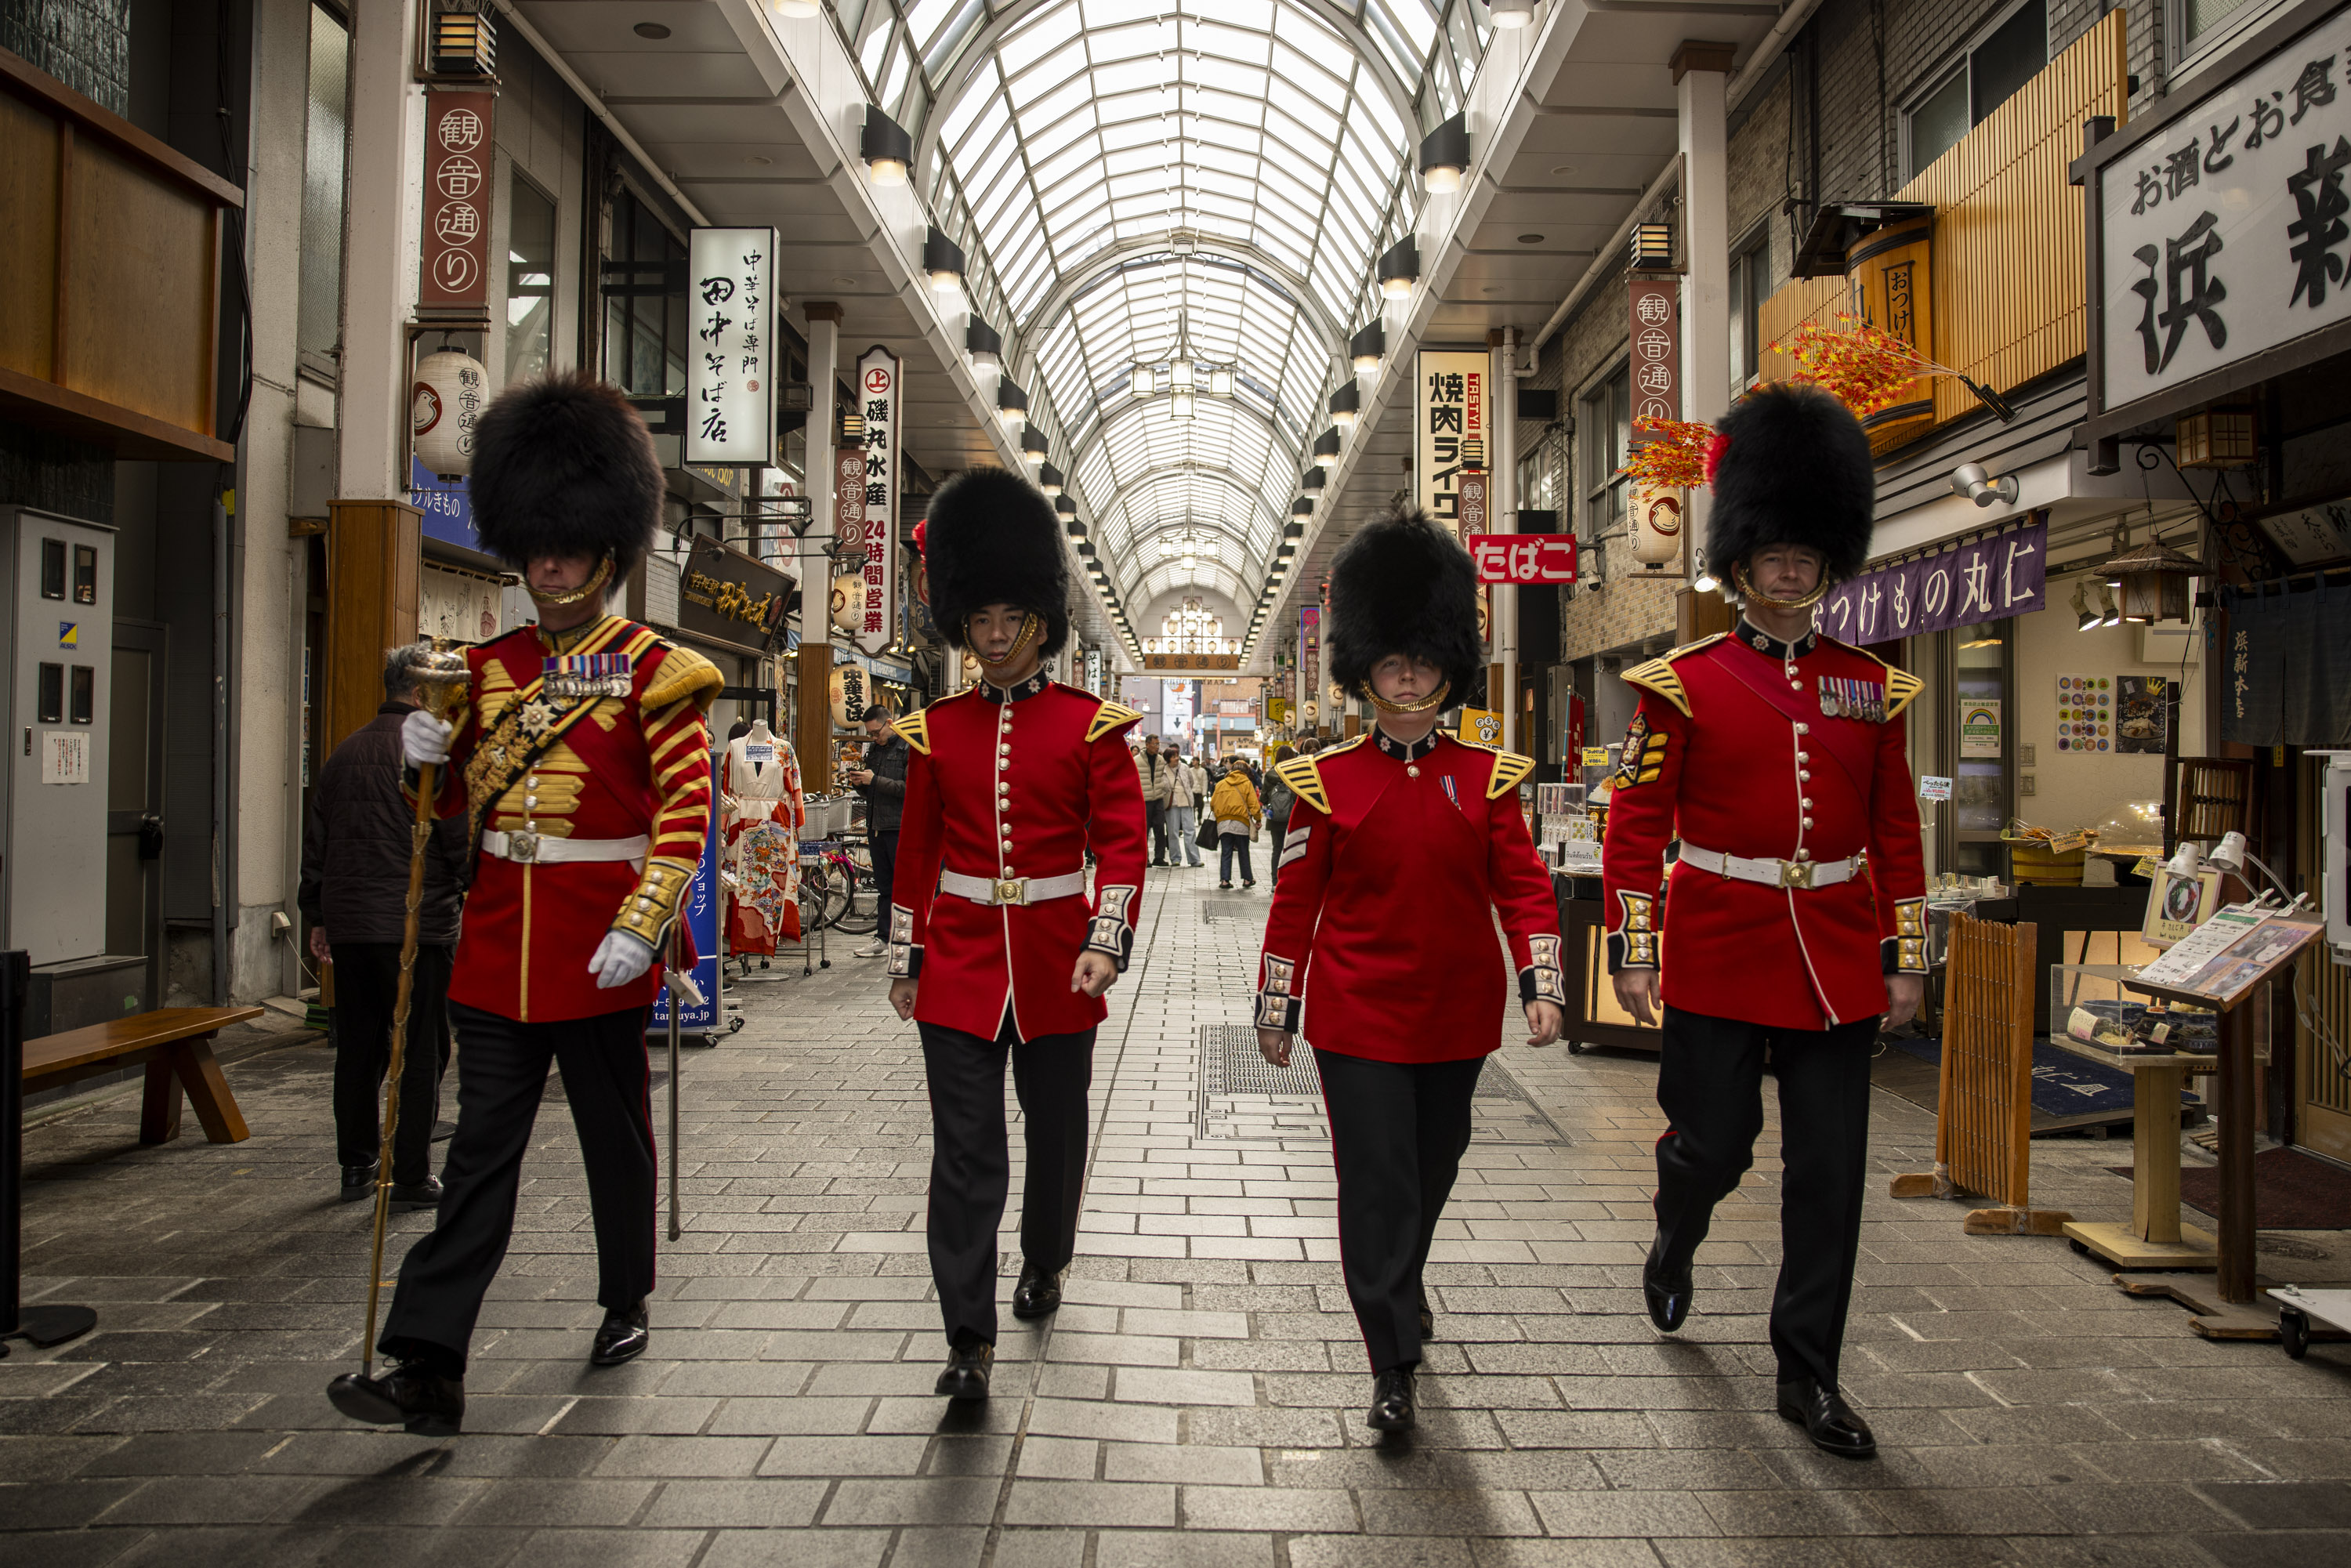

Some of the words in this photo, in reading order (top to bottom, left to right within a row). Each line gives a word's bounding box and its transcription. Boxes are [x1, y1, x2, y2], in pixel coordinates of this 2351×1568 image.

[435, 110, 482, 291] 観音通り
[699, 277, 735, 443] 田中そば店
[743, 249, 762, 375] 中華そば専門
[1638, 294, 1671, 429] 観音通り
[865, 399, 889, 506] 磯丸水産
[1429, 372, 1464, 519] 焼肉ライク
[1469, 376, 1480, 426] TASTY!
[841, 458, 863, 545] 観音通り
[863, 520, 886, 633] 24時間営業
[1474, 538, 1573, 580] たばこ
[843, 668, 864, 722] 中華そば
[2234, 630, 2249, 719] 浜新本店
